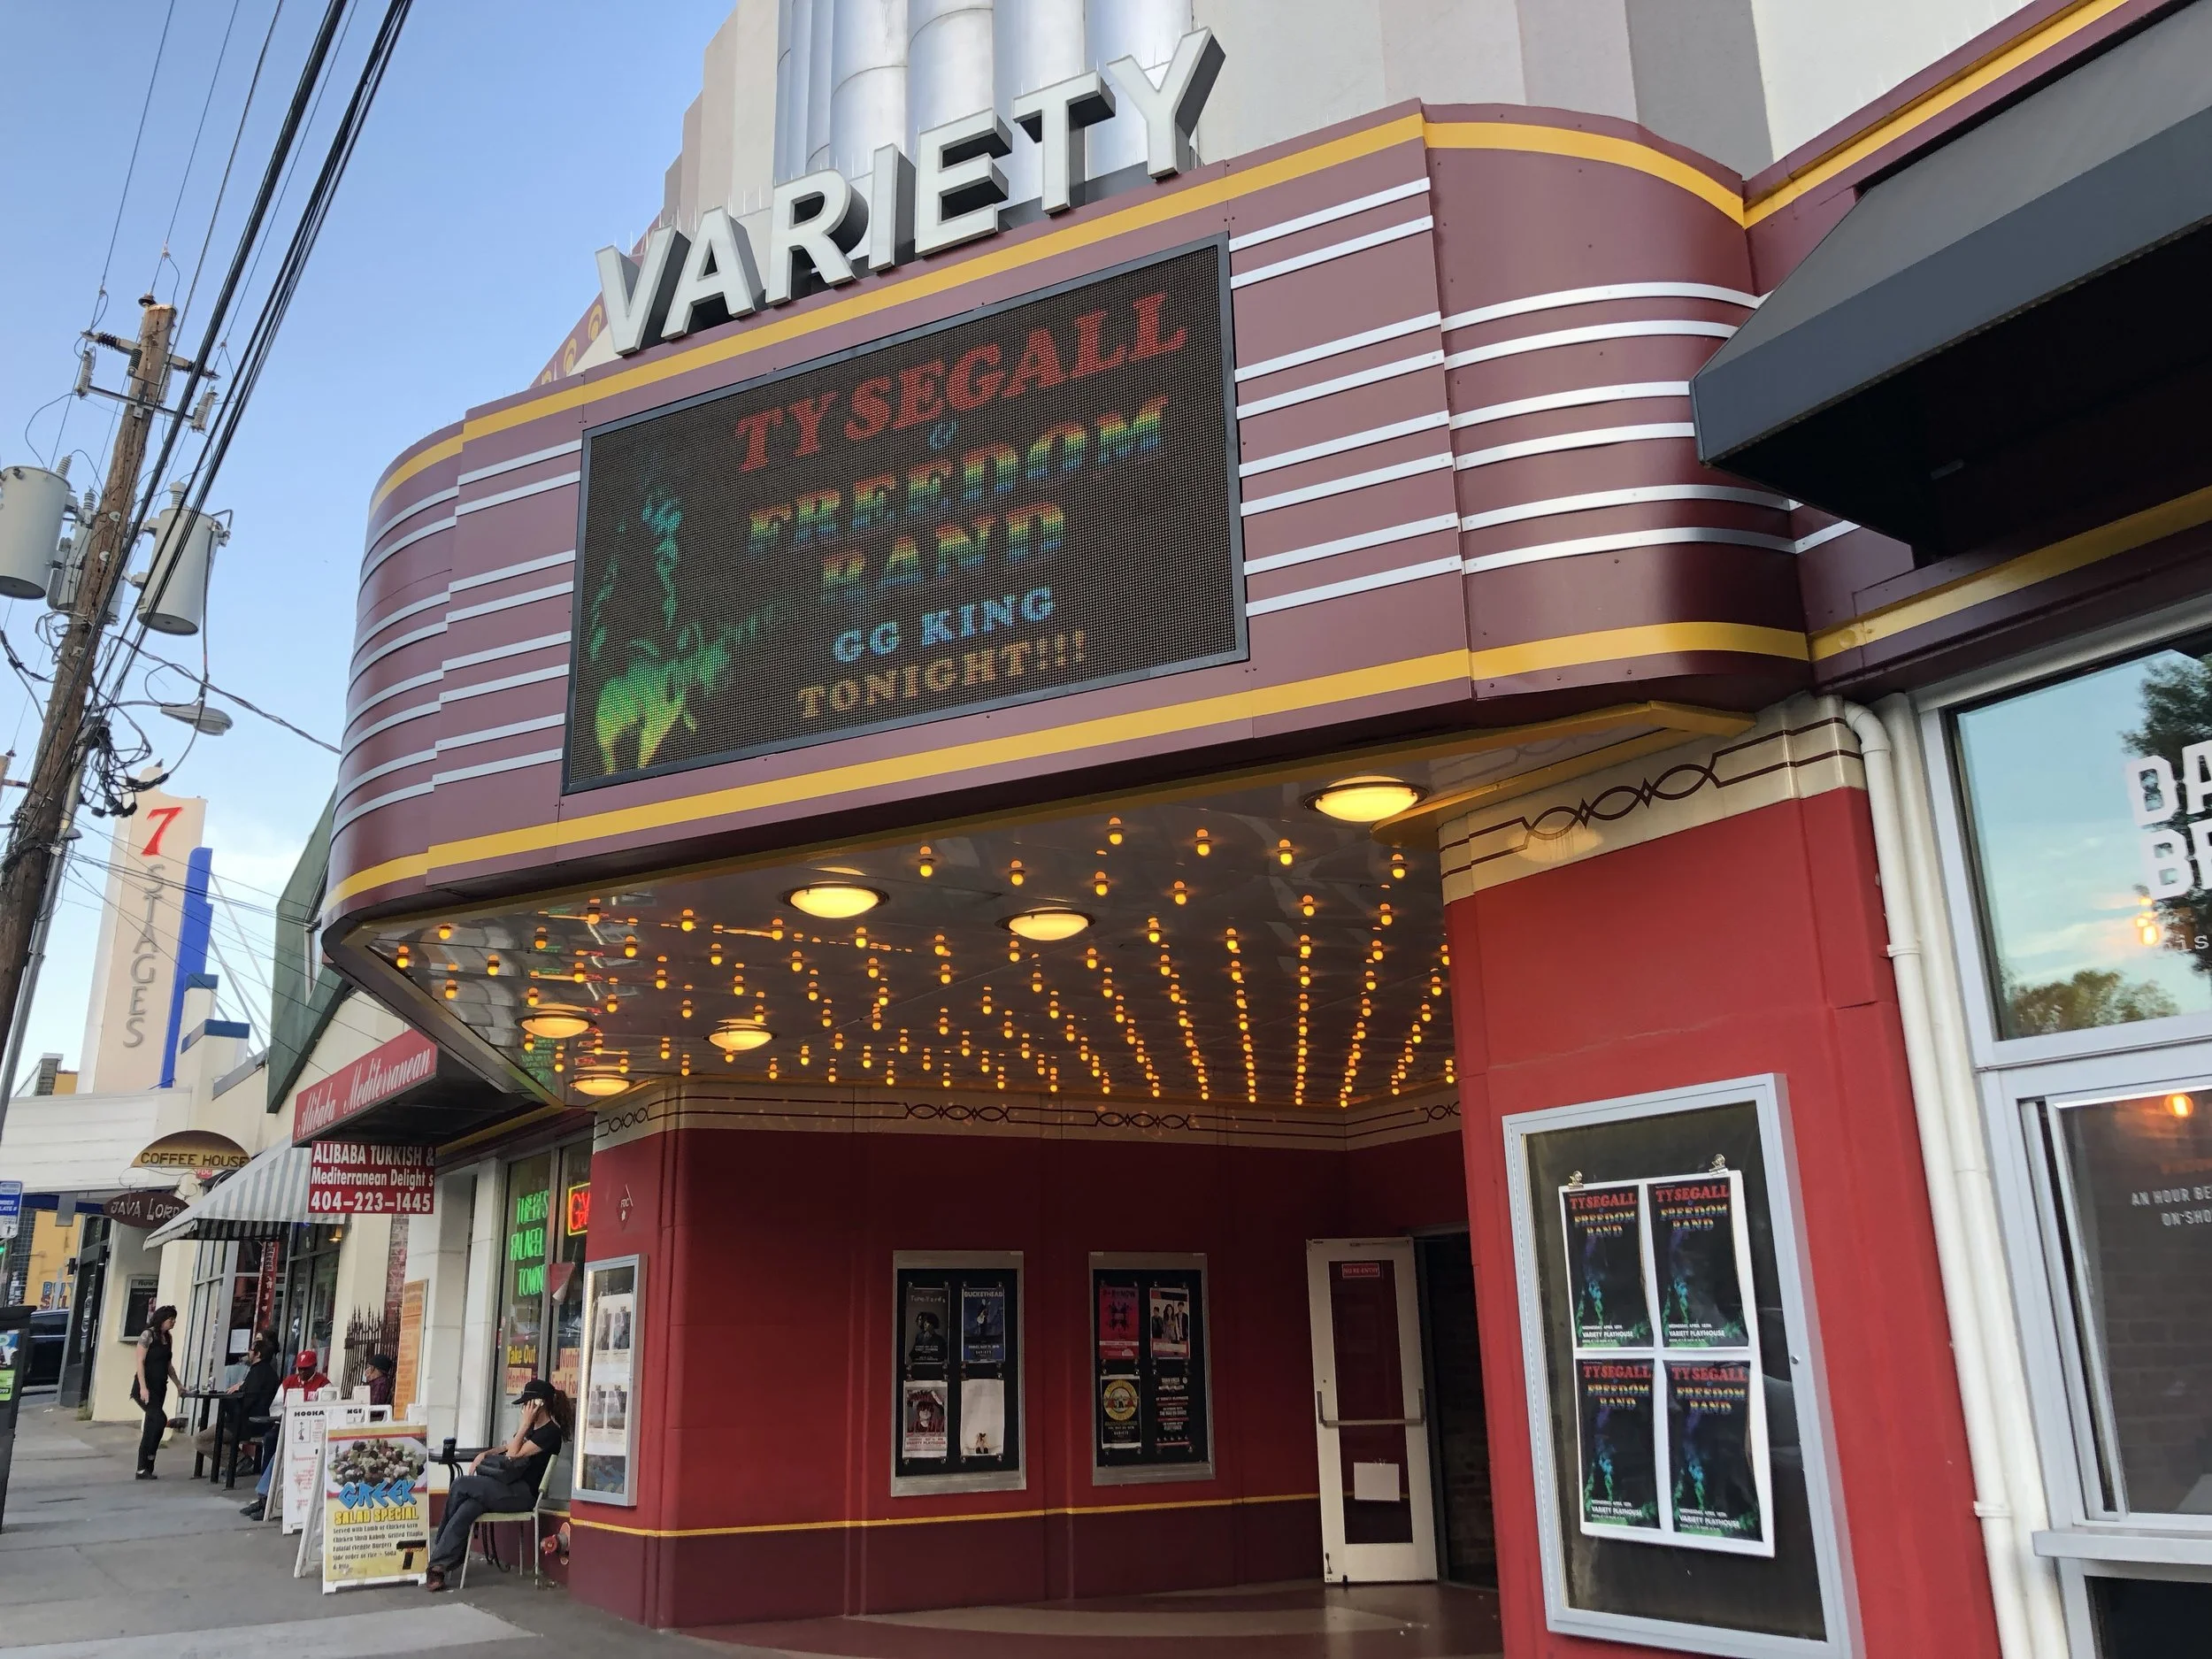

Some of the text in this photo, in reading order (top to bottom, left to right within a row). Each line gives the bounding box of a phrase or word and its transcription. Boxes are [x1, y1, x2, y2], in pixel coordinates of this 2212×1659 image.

[595, 27, 1225, 356] VARIETY
[748, 395, 1170, 555] FREEDOM
[833, 587, 1055, 663] GG KING
[797, 630, 1086, 718] TONIGHT!!!
[141, 806, 184, 857] 7
[122, 864, 166, 1049] STAGES
[343, 1048, 431, 1115] Mediterranean
[140, 1152, 250, 1168] COFFEE HOUSE
[312, 1142, 434, 1166] ALIBABA TURKISH &
[311, 1166, 388, 1187] Mediterranean
[310, 1190, 431, 1212] 404-223-1445
[2131, 1191, 2150, 1206] AN
[2152, 1187, 2191, 1205] HOUR
[110, 1200, 142, 1217] JAVA
[507, 1344, 536, 1364] Take Out
[338, 1479, 418, 1509] GREEK
[334, 1507, 419, 1525] SALAD SPECIAL
[1613, 1508, 1642, 1517] PLAYHOUSE
[1679, 1515, 1704, 1524] VARIETY
[1705, 1517, 1740, 1529] PLAYHOUSE
